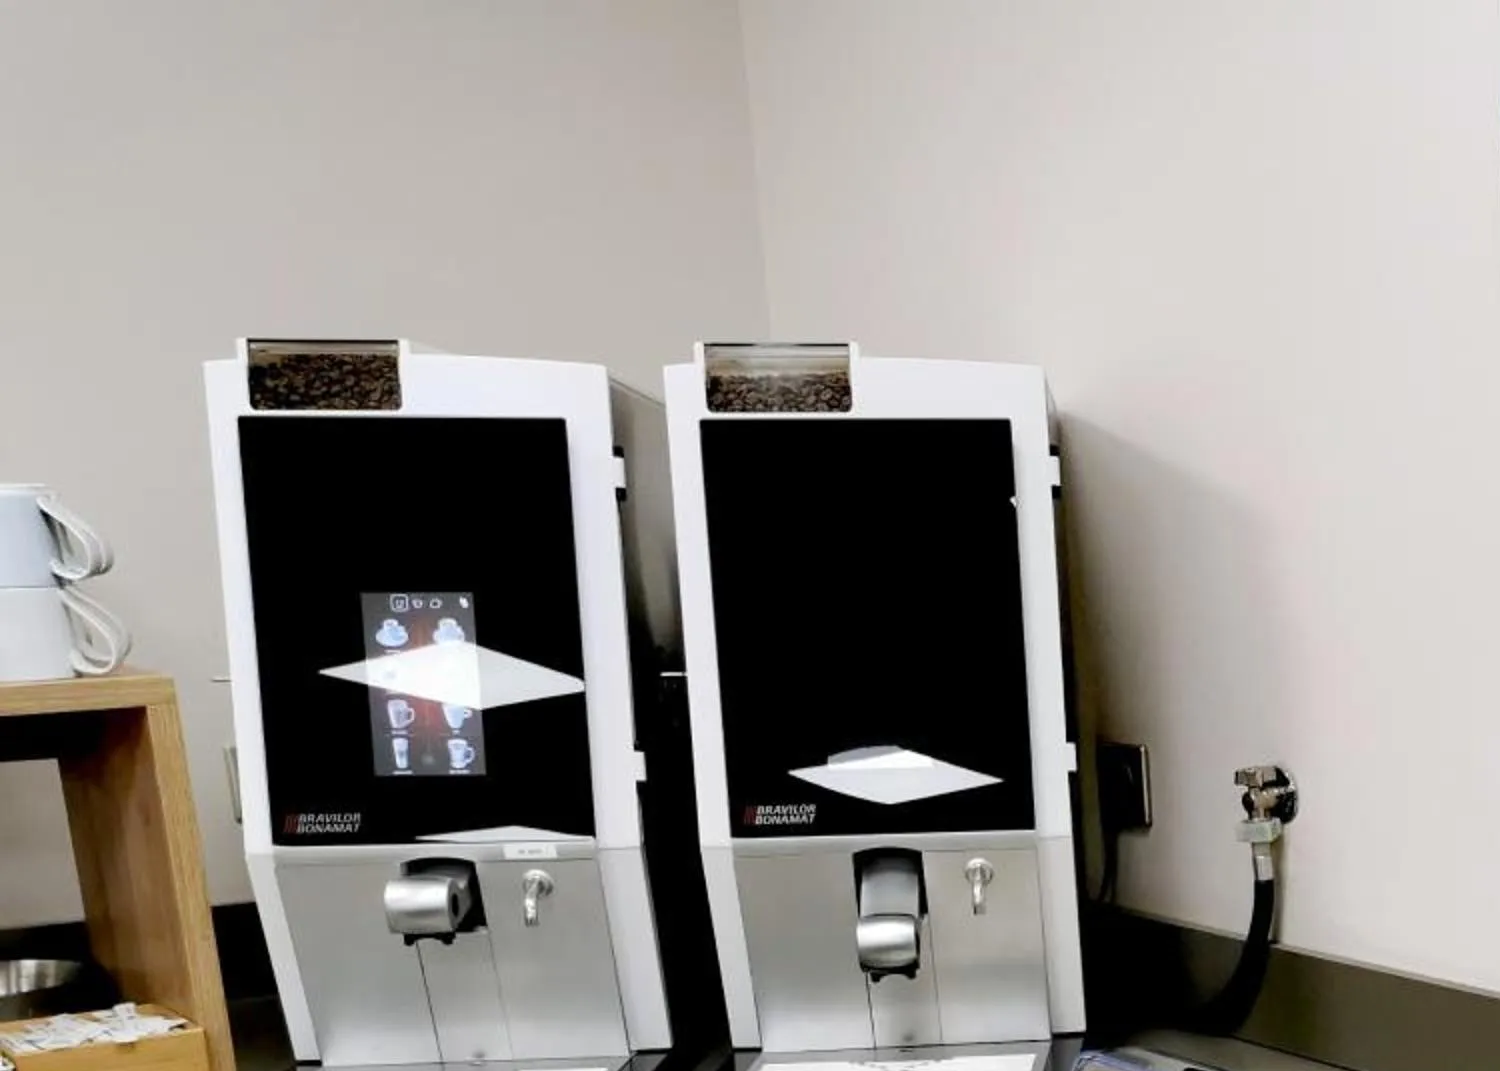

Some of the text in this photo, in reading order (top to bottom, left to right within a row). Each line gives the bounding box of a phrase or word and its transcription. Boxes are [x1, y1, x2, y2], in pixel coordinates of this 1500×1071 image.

[756, 804, 817, 815] BRAVILOR
[299, 812, 361, 823] BRAVILOR
[754, 814, 816, 826] BONAMAT
[296, 822, 360, 834] BONAMAT
